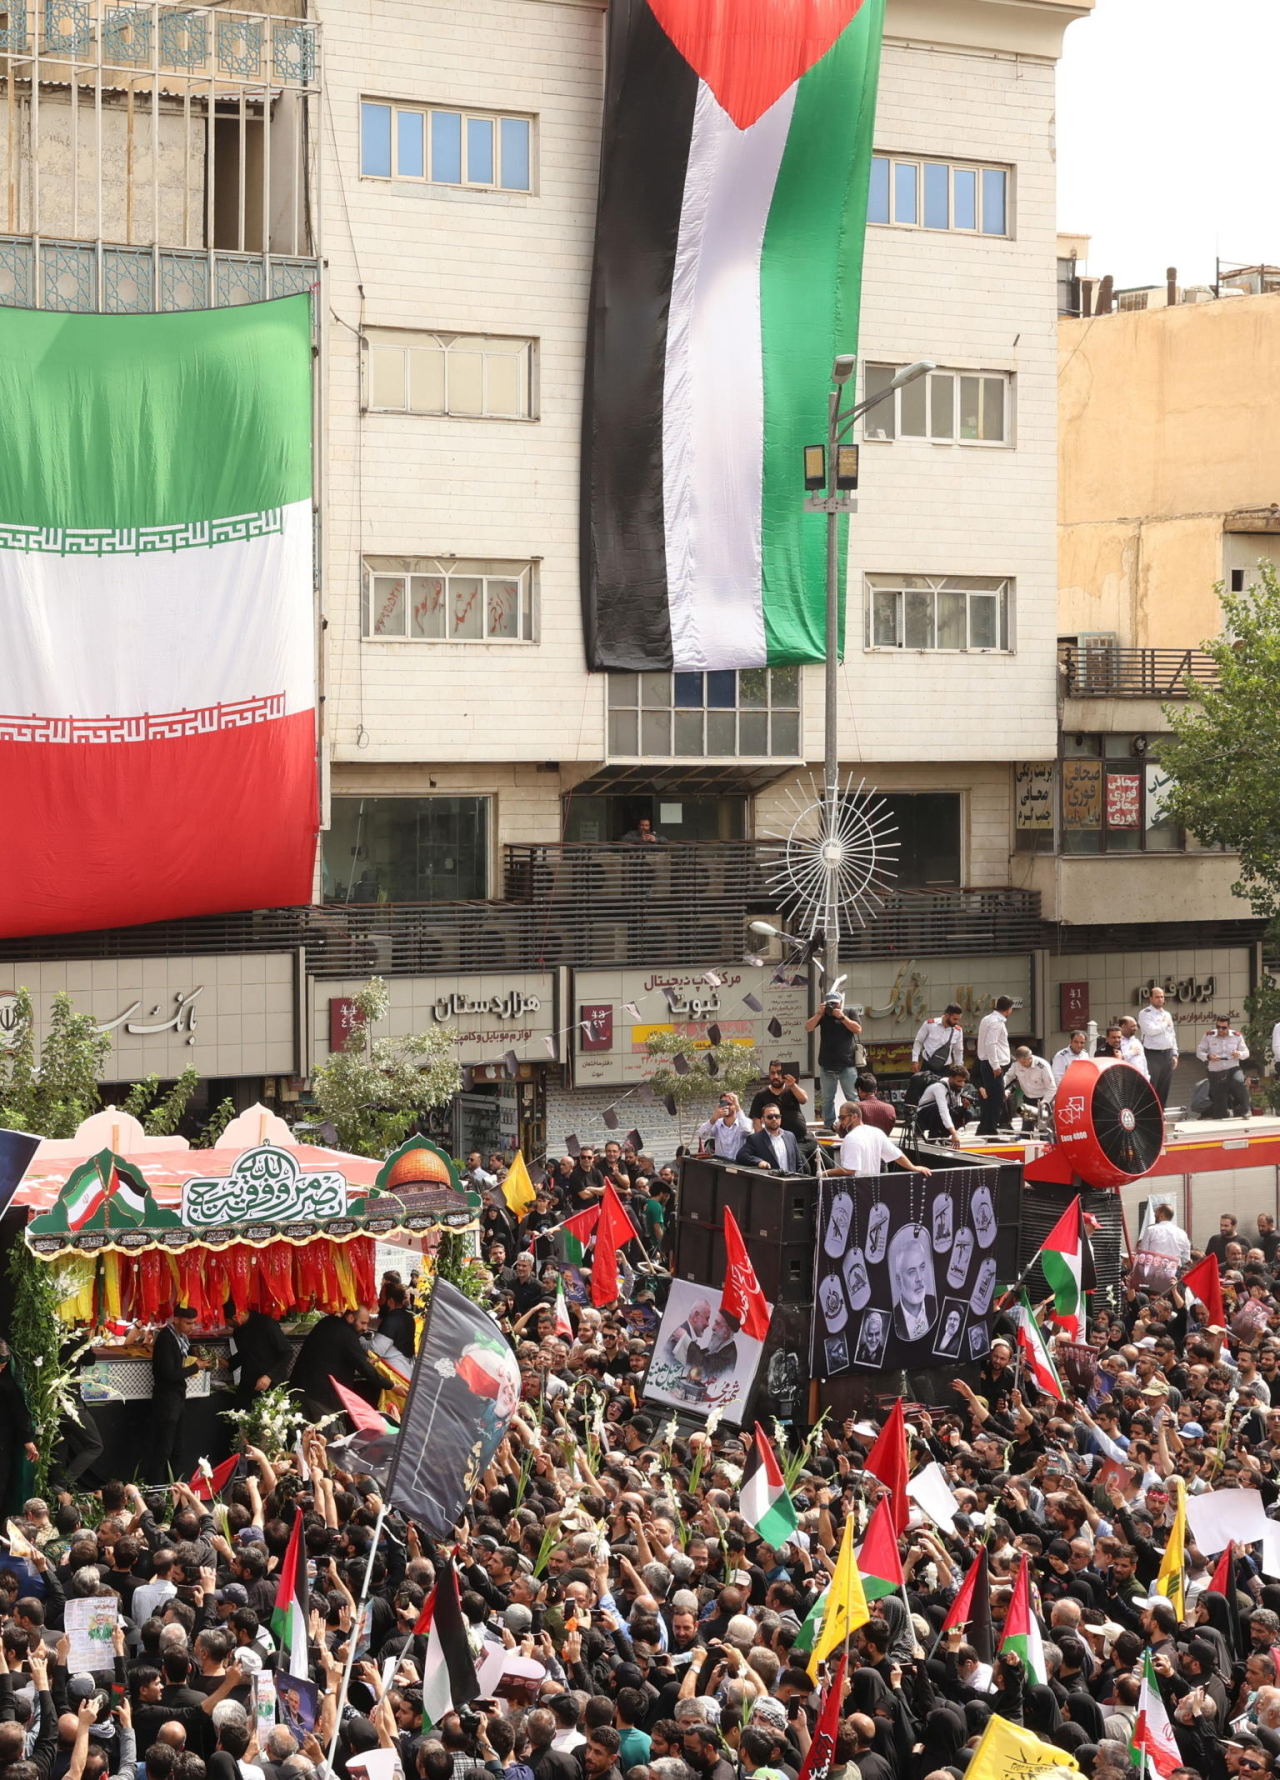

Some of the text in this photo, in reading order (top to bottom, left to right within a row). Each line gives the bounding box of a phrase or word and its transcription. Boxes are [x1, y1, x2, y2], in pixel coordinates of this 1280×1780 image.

[1107, 776, 1140, 789] صحافی
[1068, 784, 1096, 807] فوری
[1109, 788, 1137, 801] فوری
[1107, 799, 1140, 812] صحافی
[1109, 812, 1137, 826] فوری
[1069, 988, 1082, 998] 41
[1179, 976, 1218, 1003] ایران
[126, 985, 204, 1046] بانک
[1060, 1134, 1073, 1142] Easy
